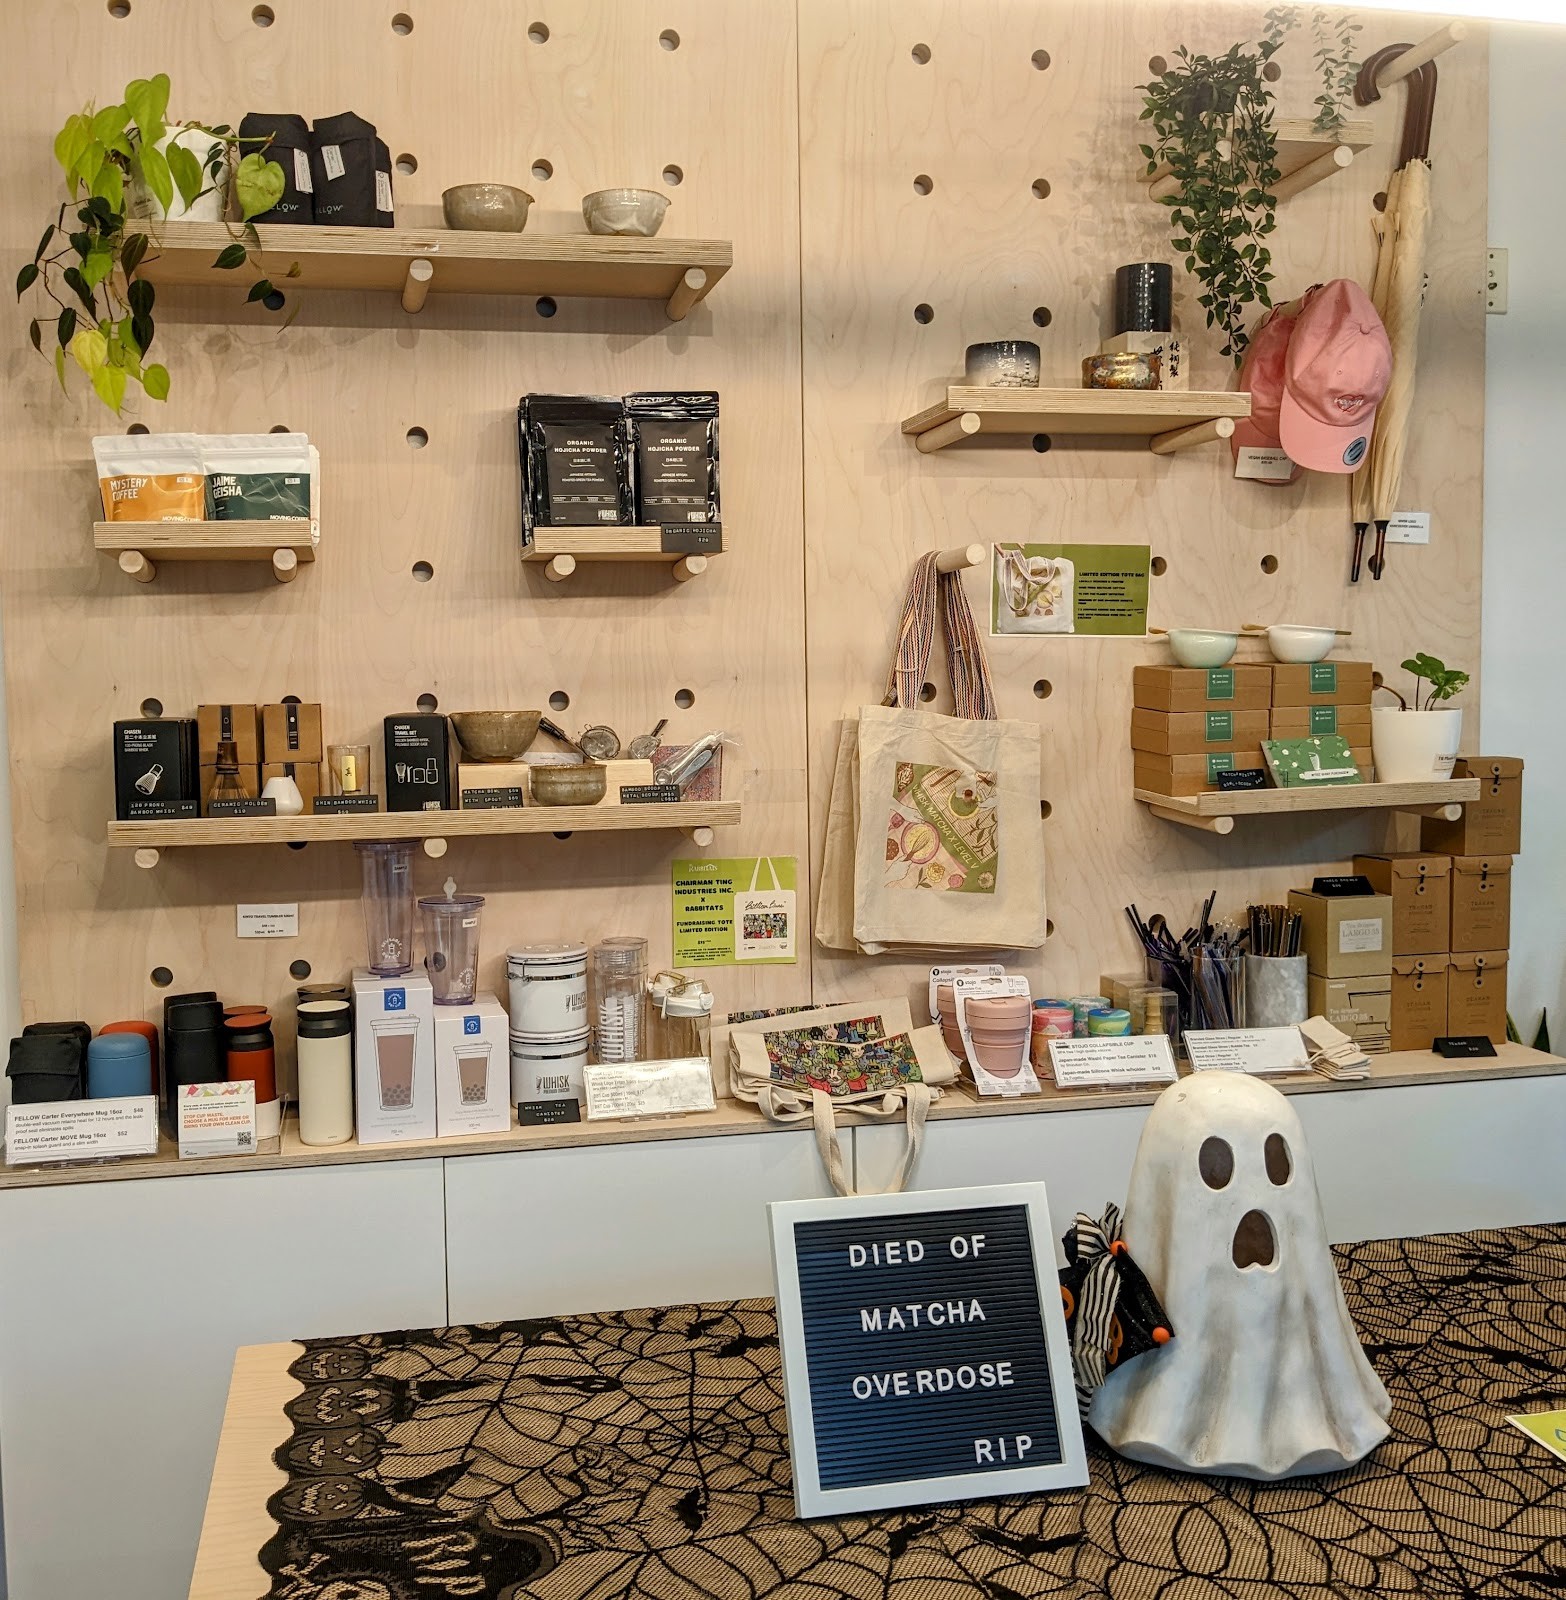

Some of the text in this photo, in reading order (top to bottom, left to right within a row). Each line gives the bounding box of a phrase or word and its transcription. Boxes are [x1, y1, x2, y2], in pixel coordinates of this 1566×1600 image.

[110, 478, 148, 491] MYSTERY
[212, 476, 236, 488] JAIME
[112, 488, 138, 501] COFFEE
[213, 486, 242, 499] GEISHA
[913, 784, 931, 808] WHISK
[926, 806, 953, 836] MATCHA
[948, 836, 958, 844] X
[953, 841, 973, 863] LEVEL
[675, 879, 713, 887] CHAIRMAN
[1342, 928, 1370, 938] LARGO
[1329, 1013, 1358, 1023] LARGO
[543, 1075, 570, 1089] WHISK
[848, 1234, 986, 1268] DIED OF
[859, 1299, 987, 1332] MATCHA
[851, 1361, 1015, 1400] OVERDOSE
[973, 1435, 1032, 1464] RIP
